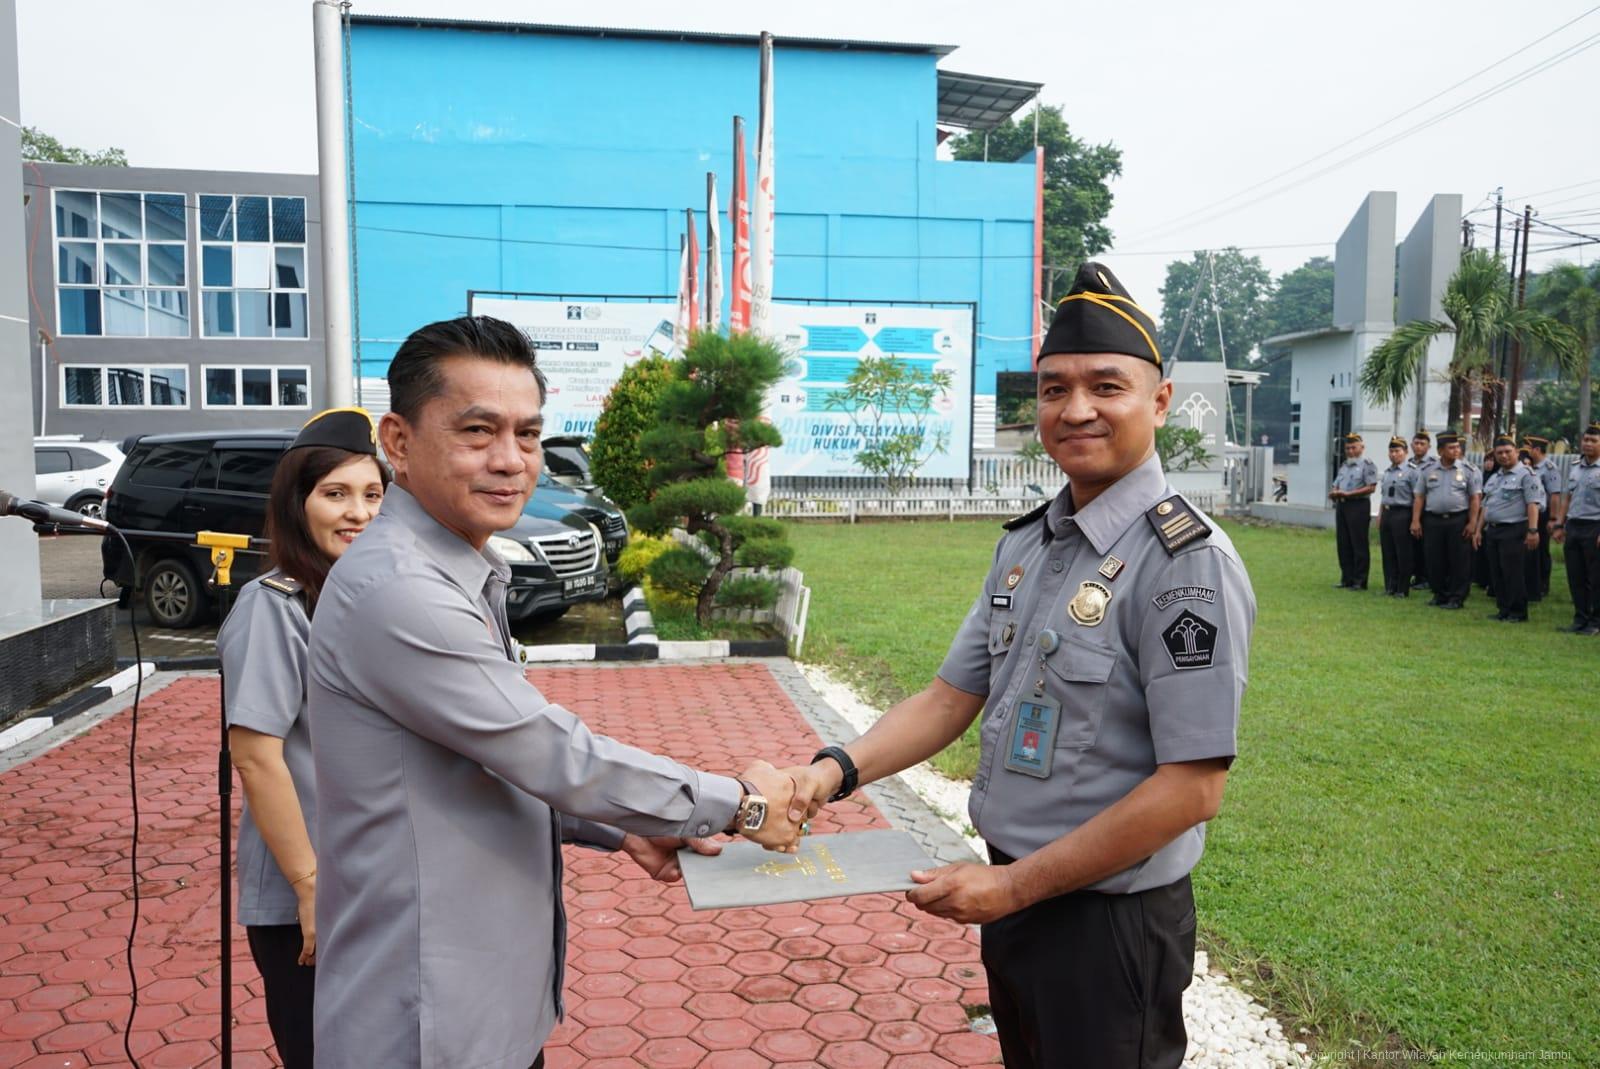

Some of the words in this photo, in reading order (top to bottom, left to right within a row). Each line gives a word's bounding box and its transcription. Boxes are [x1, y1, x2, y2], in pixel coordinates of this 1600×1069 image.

[811, 424, 850, 436] DIVISI
[813, 438, 859, 449] HUKUM
[1157, 587, 1214, 606] KEMENKUMHAM
